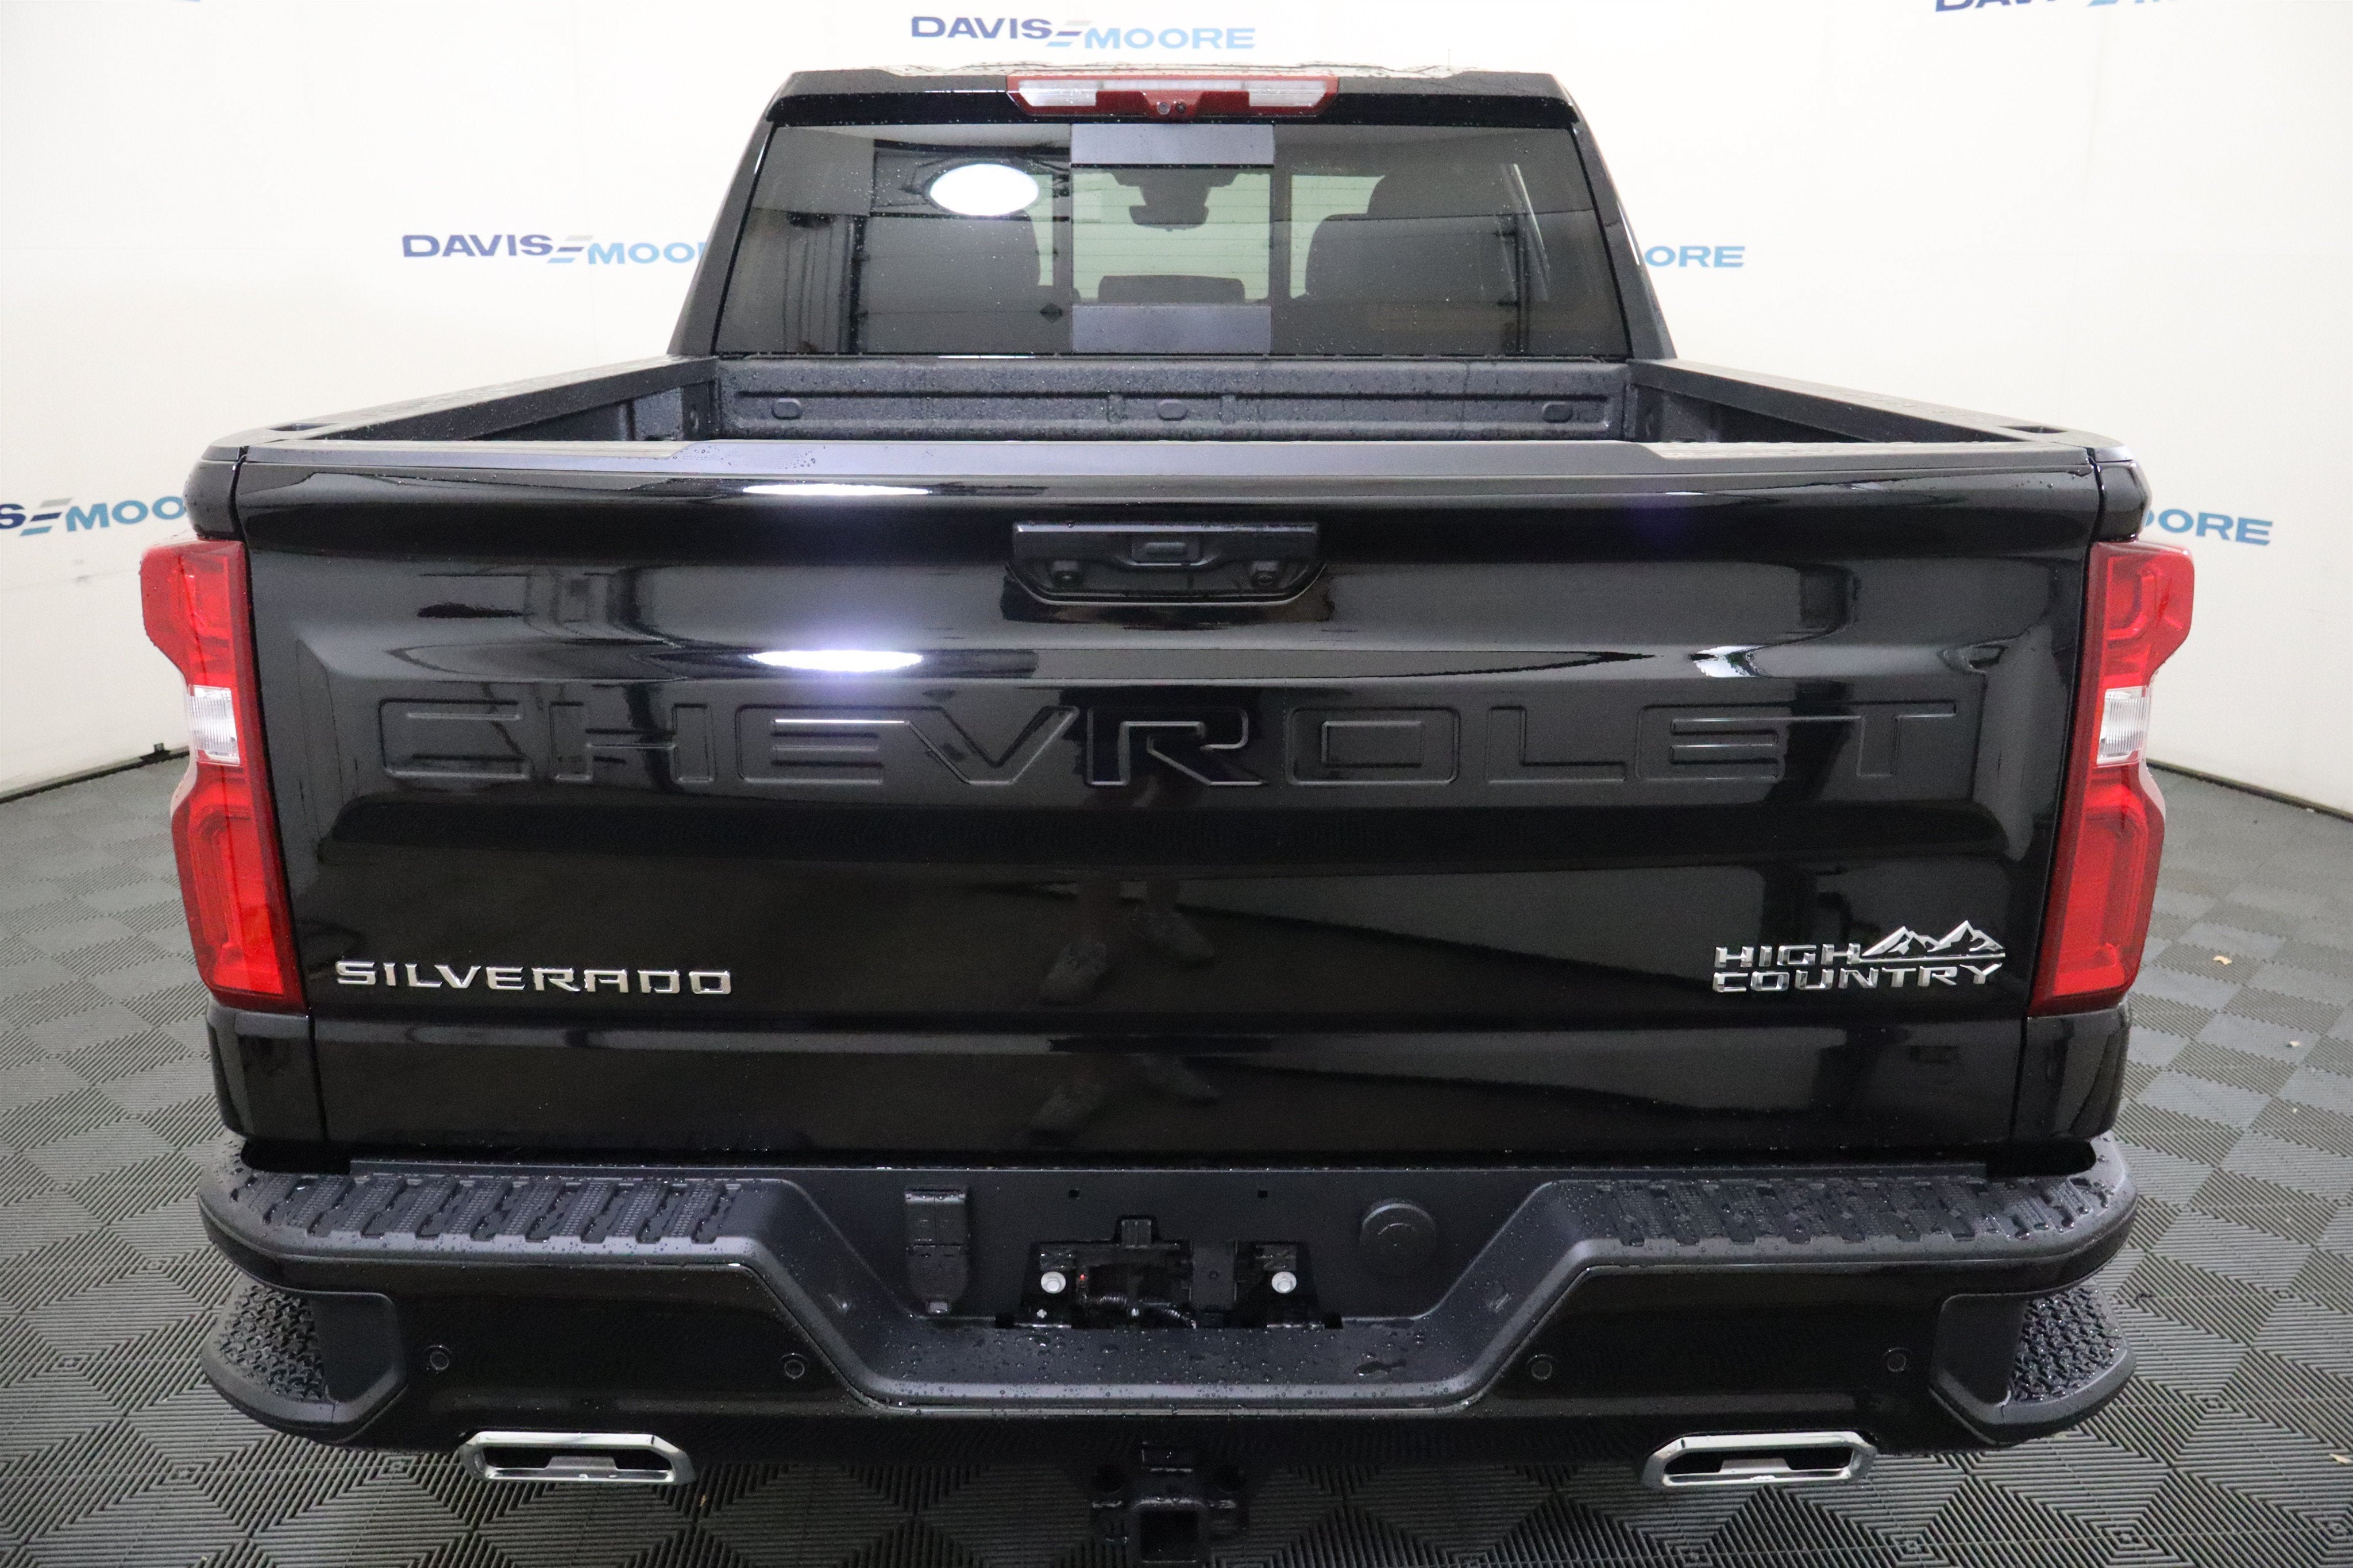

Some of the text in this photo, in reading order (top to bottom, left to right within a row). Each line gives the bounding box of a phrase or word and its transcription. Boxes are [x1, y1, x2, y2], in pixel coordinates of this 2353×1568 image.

[912, 16, 1256, 49] DAVIS MOORE
[402, 234, 707, 264] DAVIS MOO
[1644, 245, 1745, 268] ORE
[65, 496, 187, 532] MOO
[2144, 509, 2273, 546] ORE
[378, 697, 1957, 787] CHEVROLET
[1715, 943, 1862, 968] HIGH
[335, 960, 732, 995] SILVERADO
[1712, 962, 2003, 992] COUNTRY
